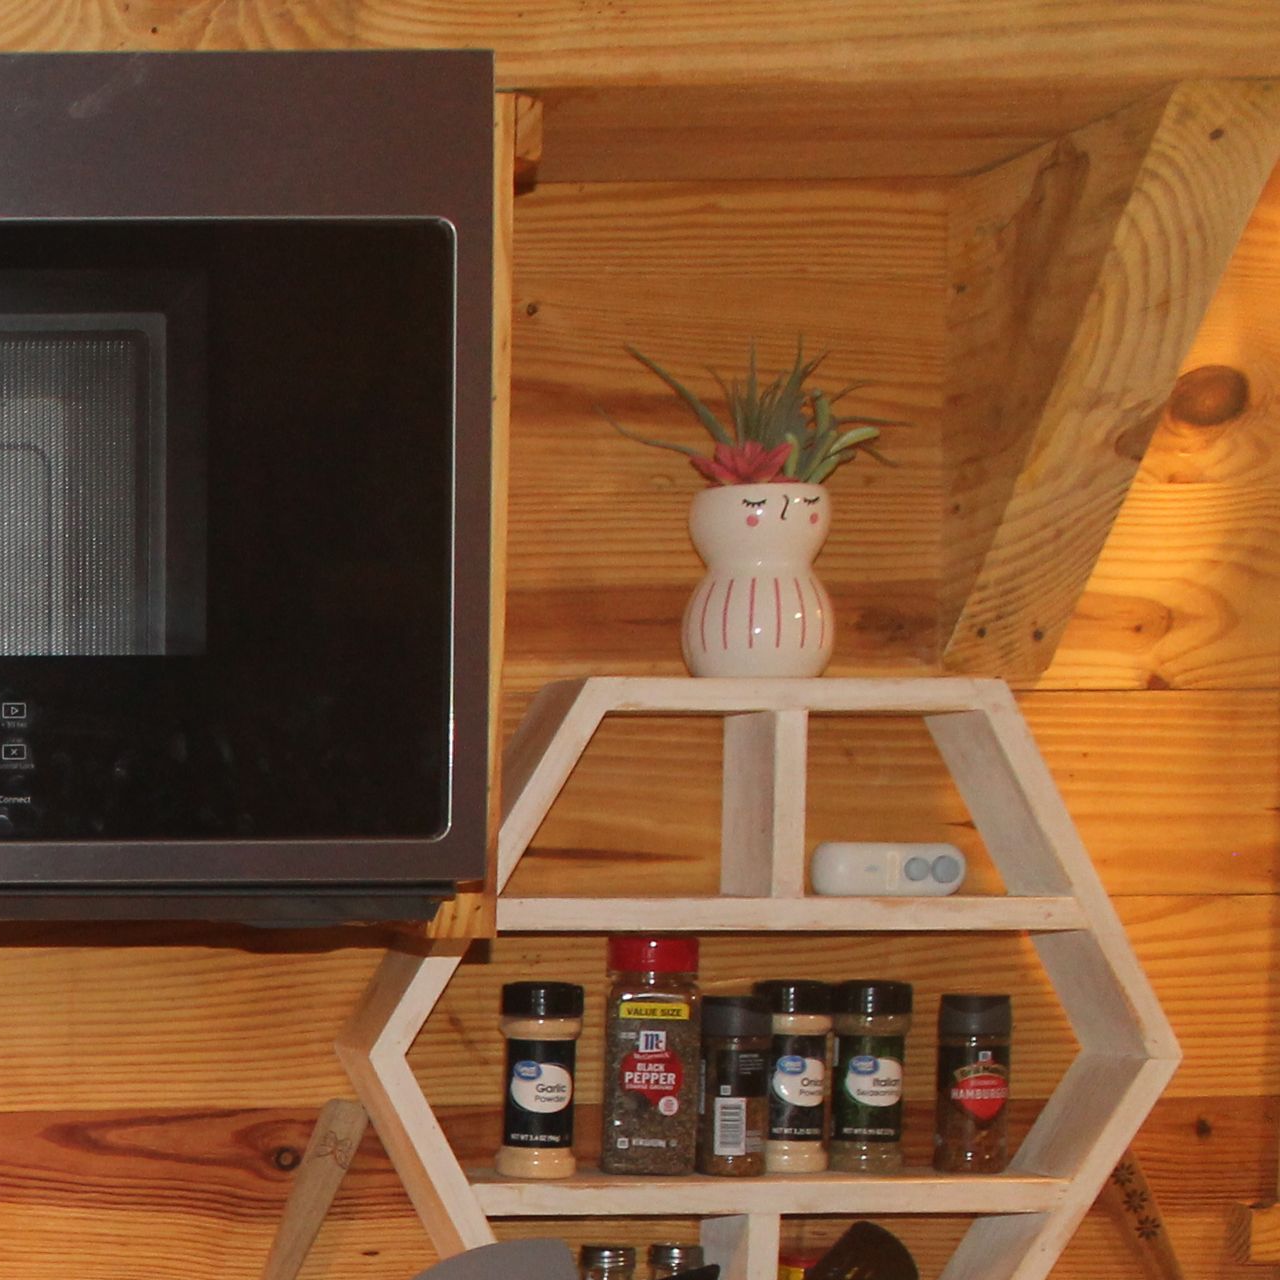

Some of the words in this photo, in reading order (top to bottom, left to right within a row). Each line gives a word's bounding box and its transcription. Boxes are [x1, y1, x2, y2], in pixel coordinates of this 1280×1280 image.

[626, 1007, 657, 1016] VALUE
[660, 1008, 683, 1017] SIZE
[636, 1062, 666, 1072] BLACK
[624, 1071, 677, 1085] PEPPER
[535, 1082, 567, 1094] Garlic
[535, 1094, 567, 1104] Powder
